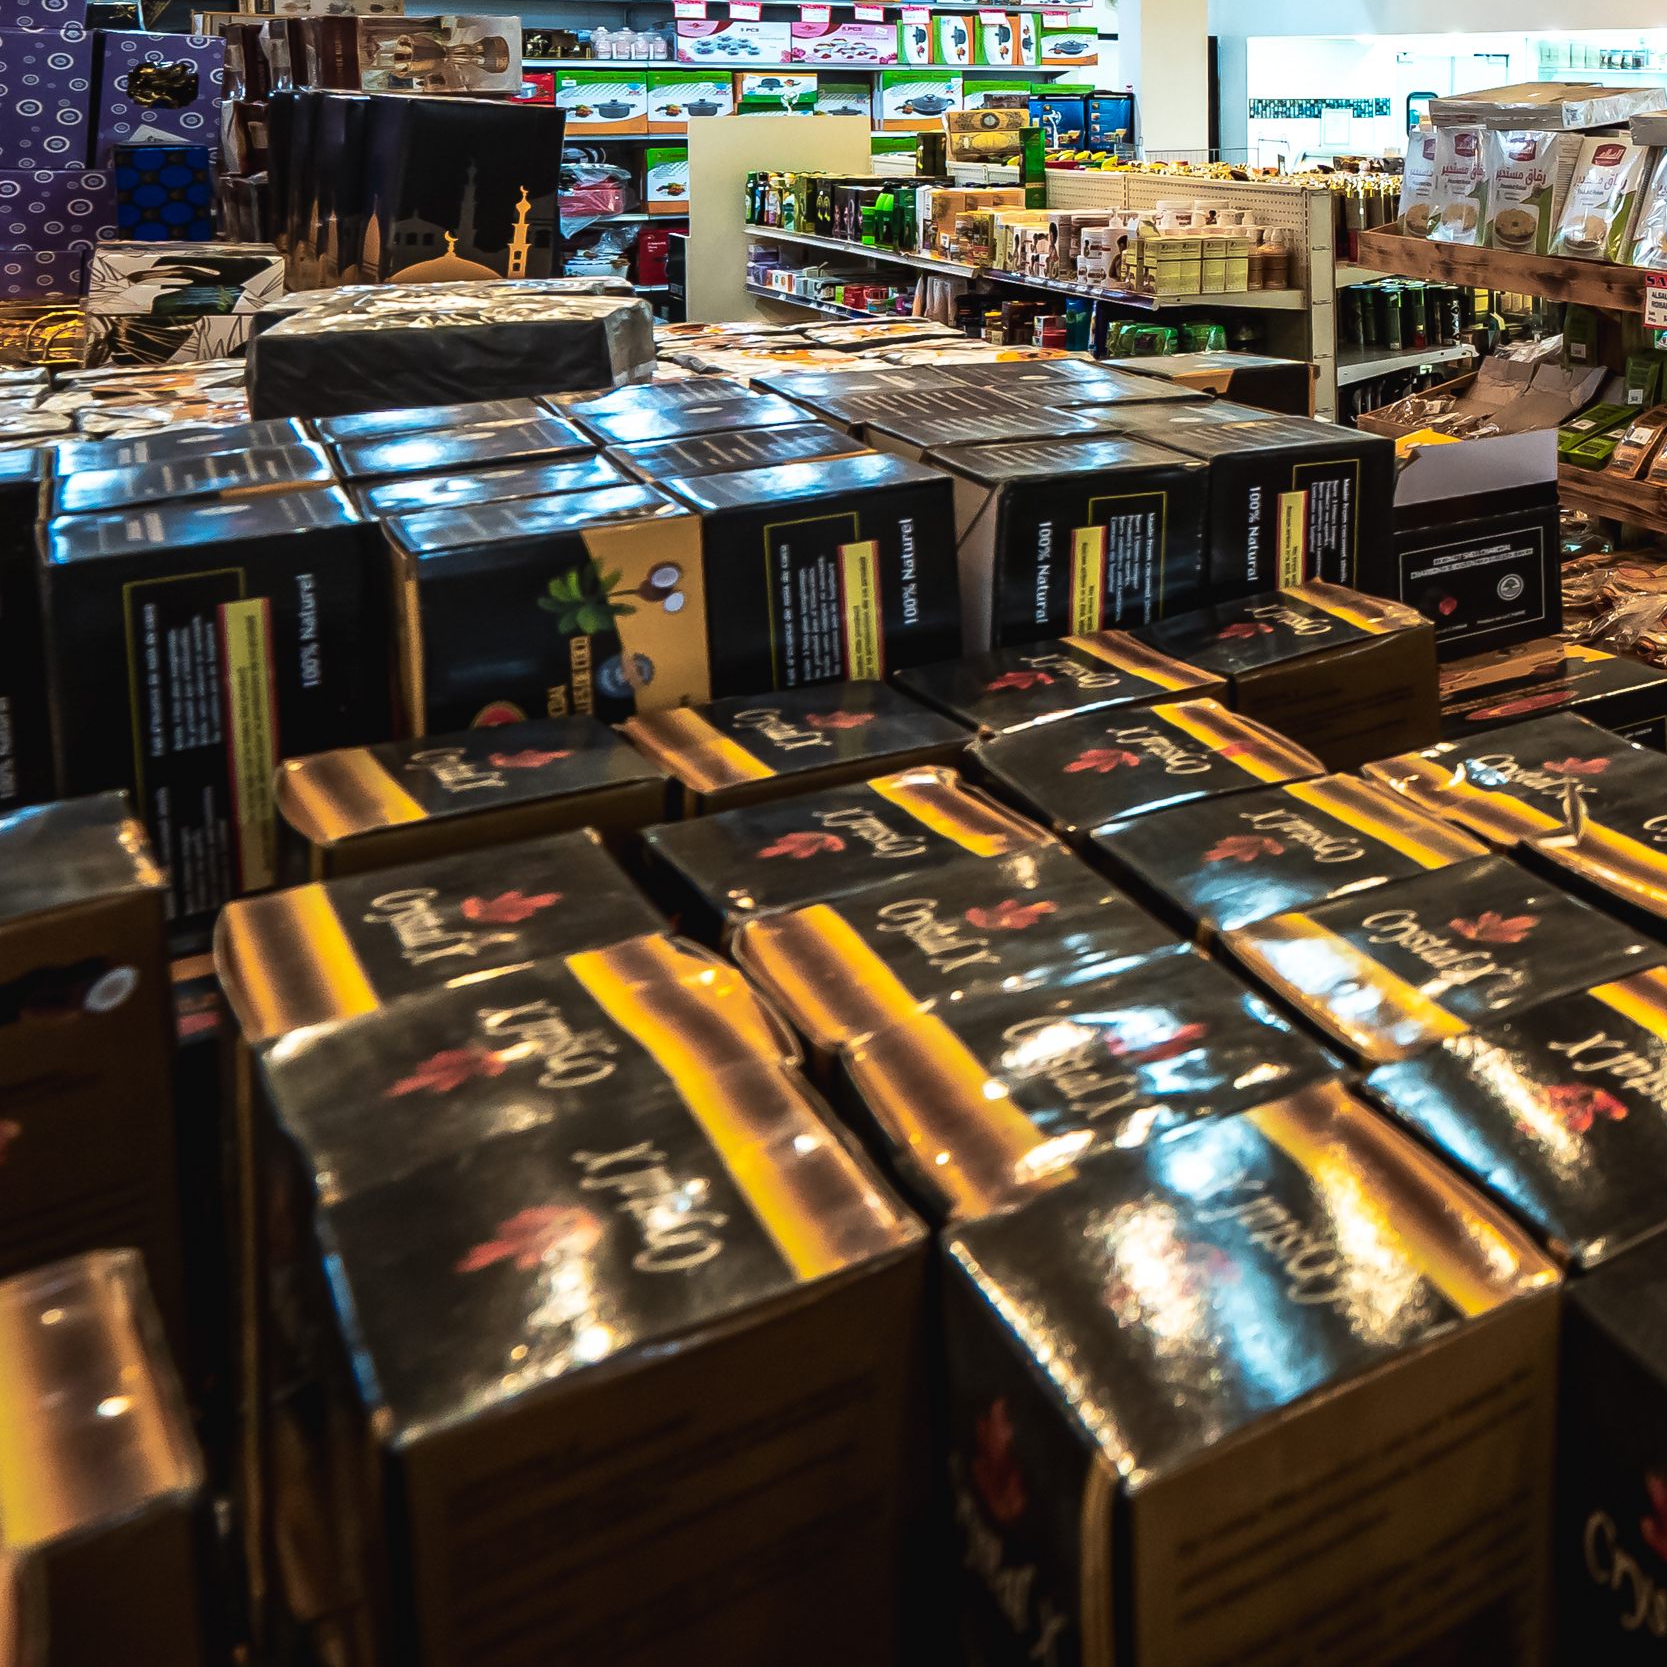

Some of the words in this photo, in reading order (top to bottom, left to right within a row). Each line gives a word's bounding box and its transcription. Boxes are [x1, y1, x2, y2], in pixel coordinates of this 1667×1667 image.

[1248, 486, 1261, 523] 100%
[898, 518, 914, 579] Naturel
[1037, 521, 1052, 560] 100%
[1247, 527, 1259, 581] Natural
[296, 572, 317, 639] Naturel
[903, 583, 919, 624] 100%
[1035, 565, 1050, 624] Natural
[301, 644, 322, 688] 100%
